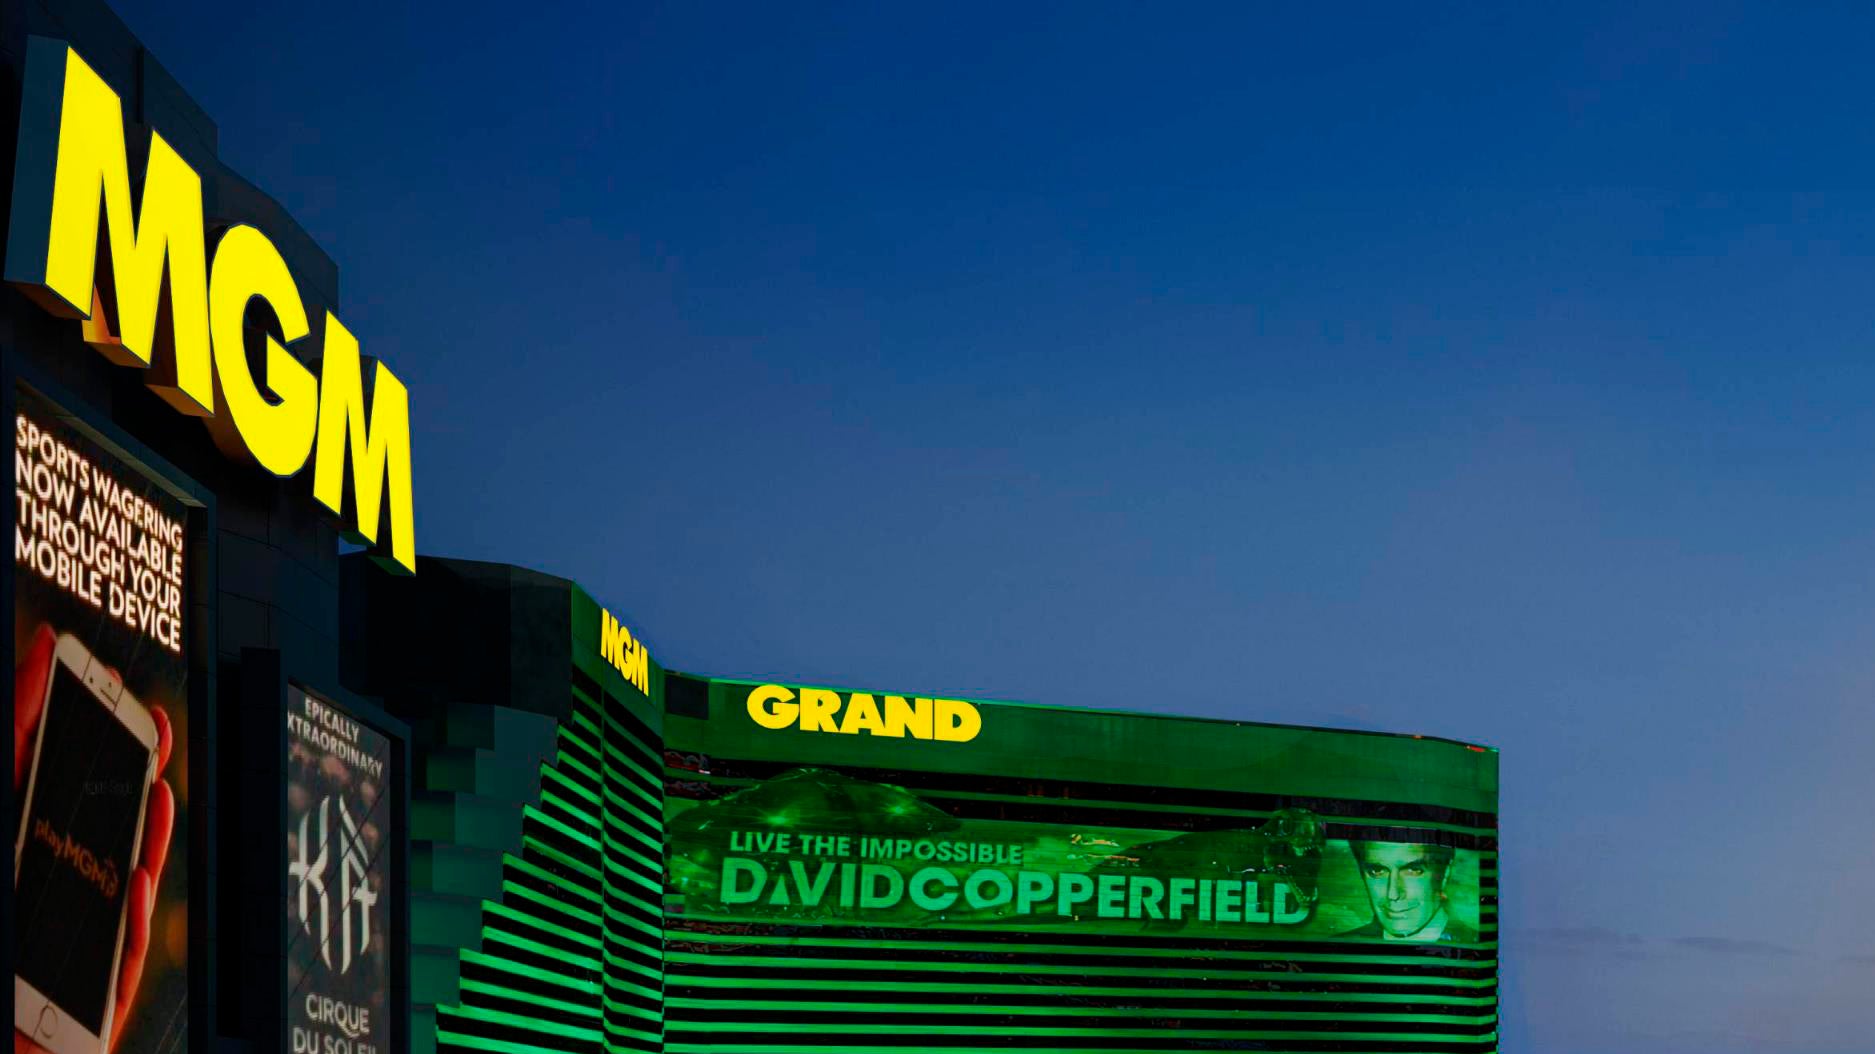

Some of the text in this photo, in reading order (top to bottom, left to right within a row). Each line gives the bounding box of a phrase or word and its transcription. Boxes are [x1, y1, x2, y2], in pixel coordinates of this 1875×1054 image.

[45, 46, 416, 576] MGM
[15, 450, 182, 586] NOW AVAILABLE
[16, 414, 182, 553] SPORTS WAGERING
[15, 525, 181, 652] MOBILE DEVICE
[16, 488, 181, 619] THROUGH YOUR
[601, 607, 649, 697] MGM
[305, 697, 359, 743] EPICALLY
[747, 684, 982, 742] GRAND
[729, 831, 1023, 865] LIVE THE IMPOSSIBLE
[306, 993, 370, 1038] CIRQUE
